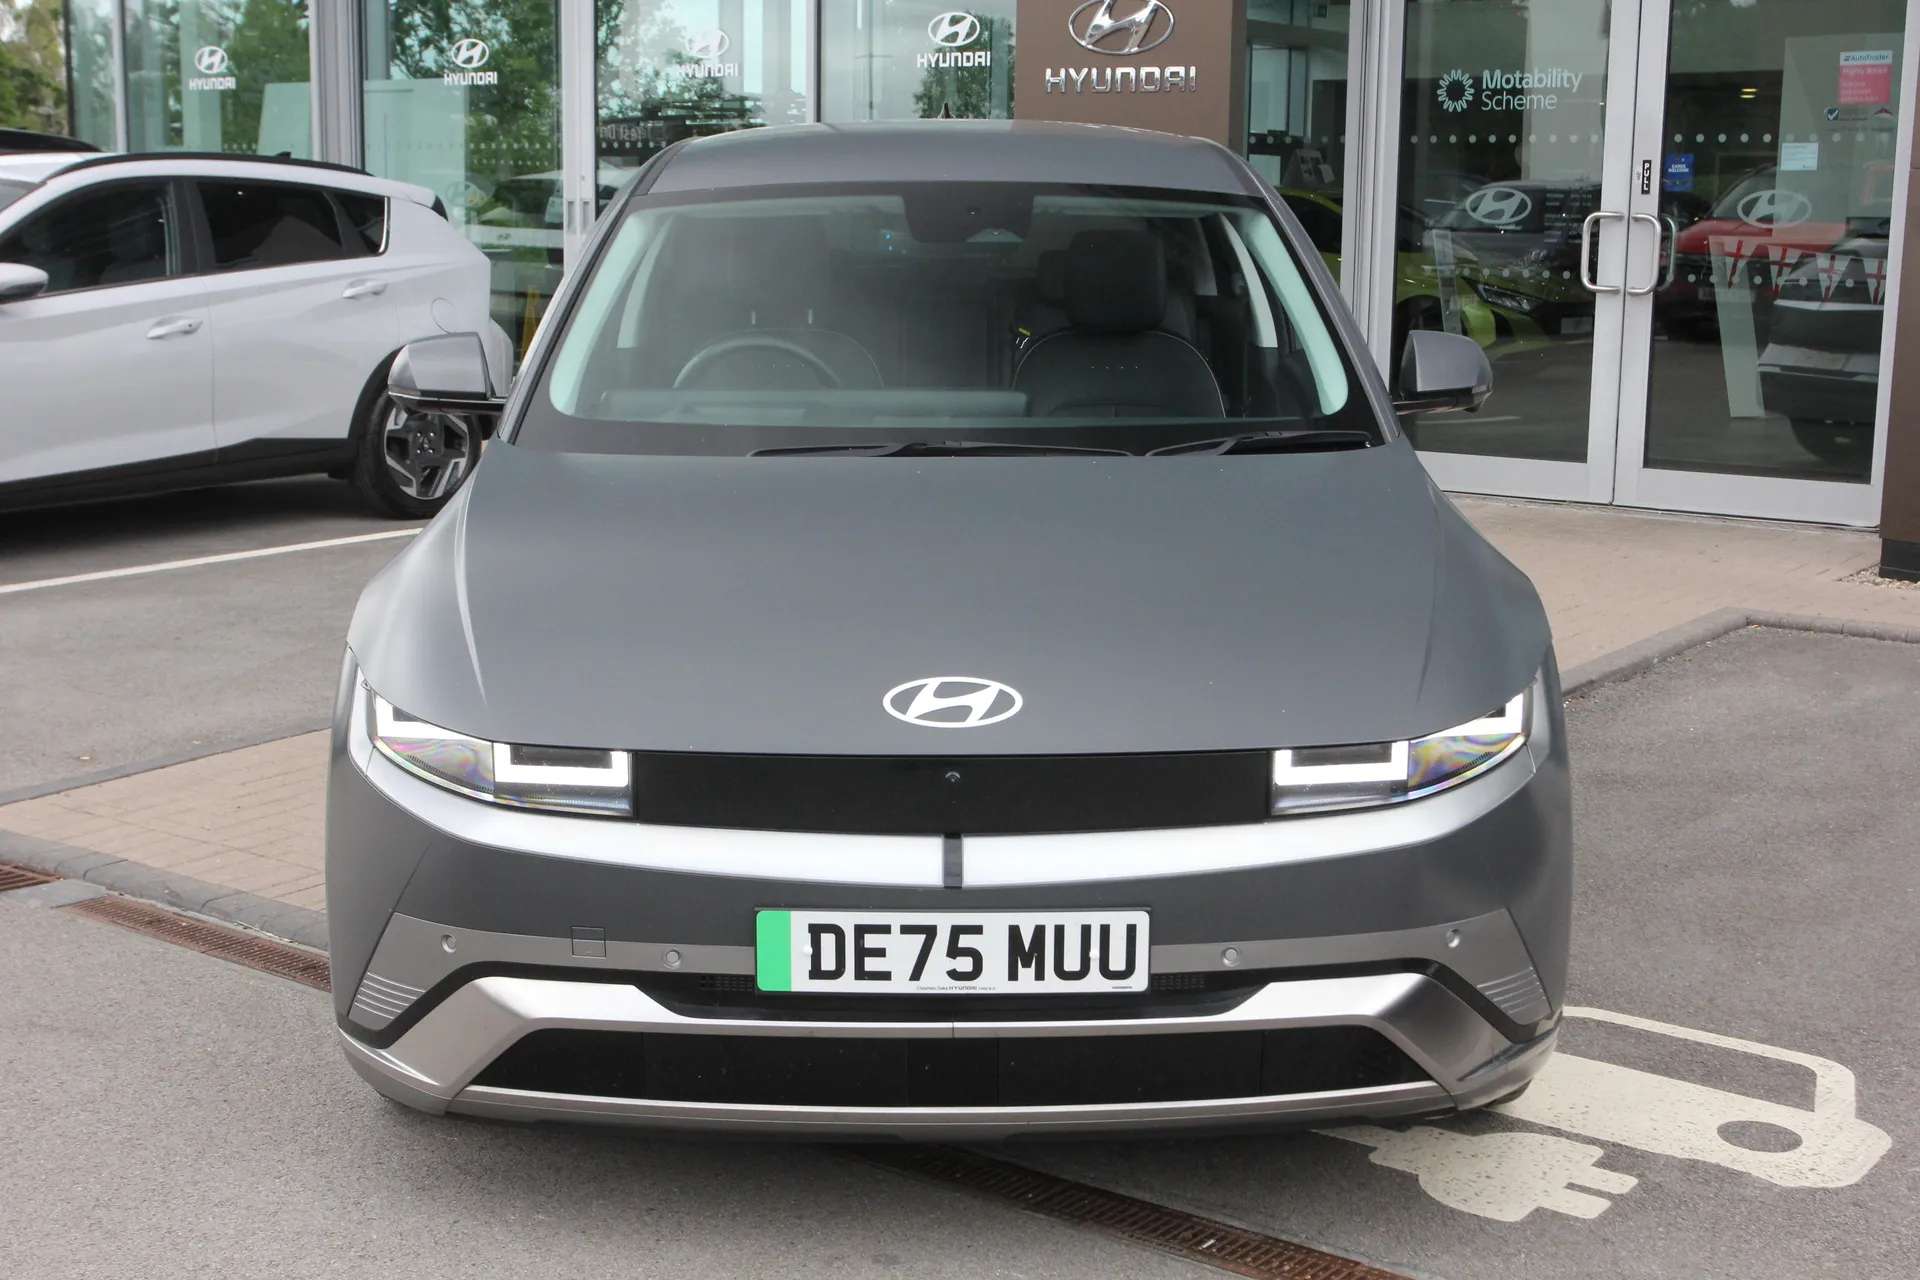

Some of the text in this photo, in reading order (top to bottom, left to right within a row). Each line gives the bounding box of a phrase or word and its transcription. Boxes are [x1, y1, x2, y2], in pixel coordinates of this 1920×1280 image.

[917, 51, 991, 68] HYUNDAI
[444, 71, 498, 85] HYUNDAI
[676, 63, 738, 78] HYUNDAI
[1045, 65, 1197, 94] HYUNDAI
[1482, 67, 1584, 93] Motability
[189, 76, 236, 91] HYUNDAI
[1481, 91, 1558, 111] Scheme
[1643, 162, 1651, 191] PULL
[808, 923, 1138, 982] DE75 MUU
